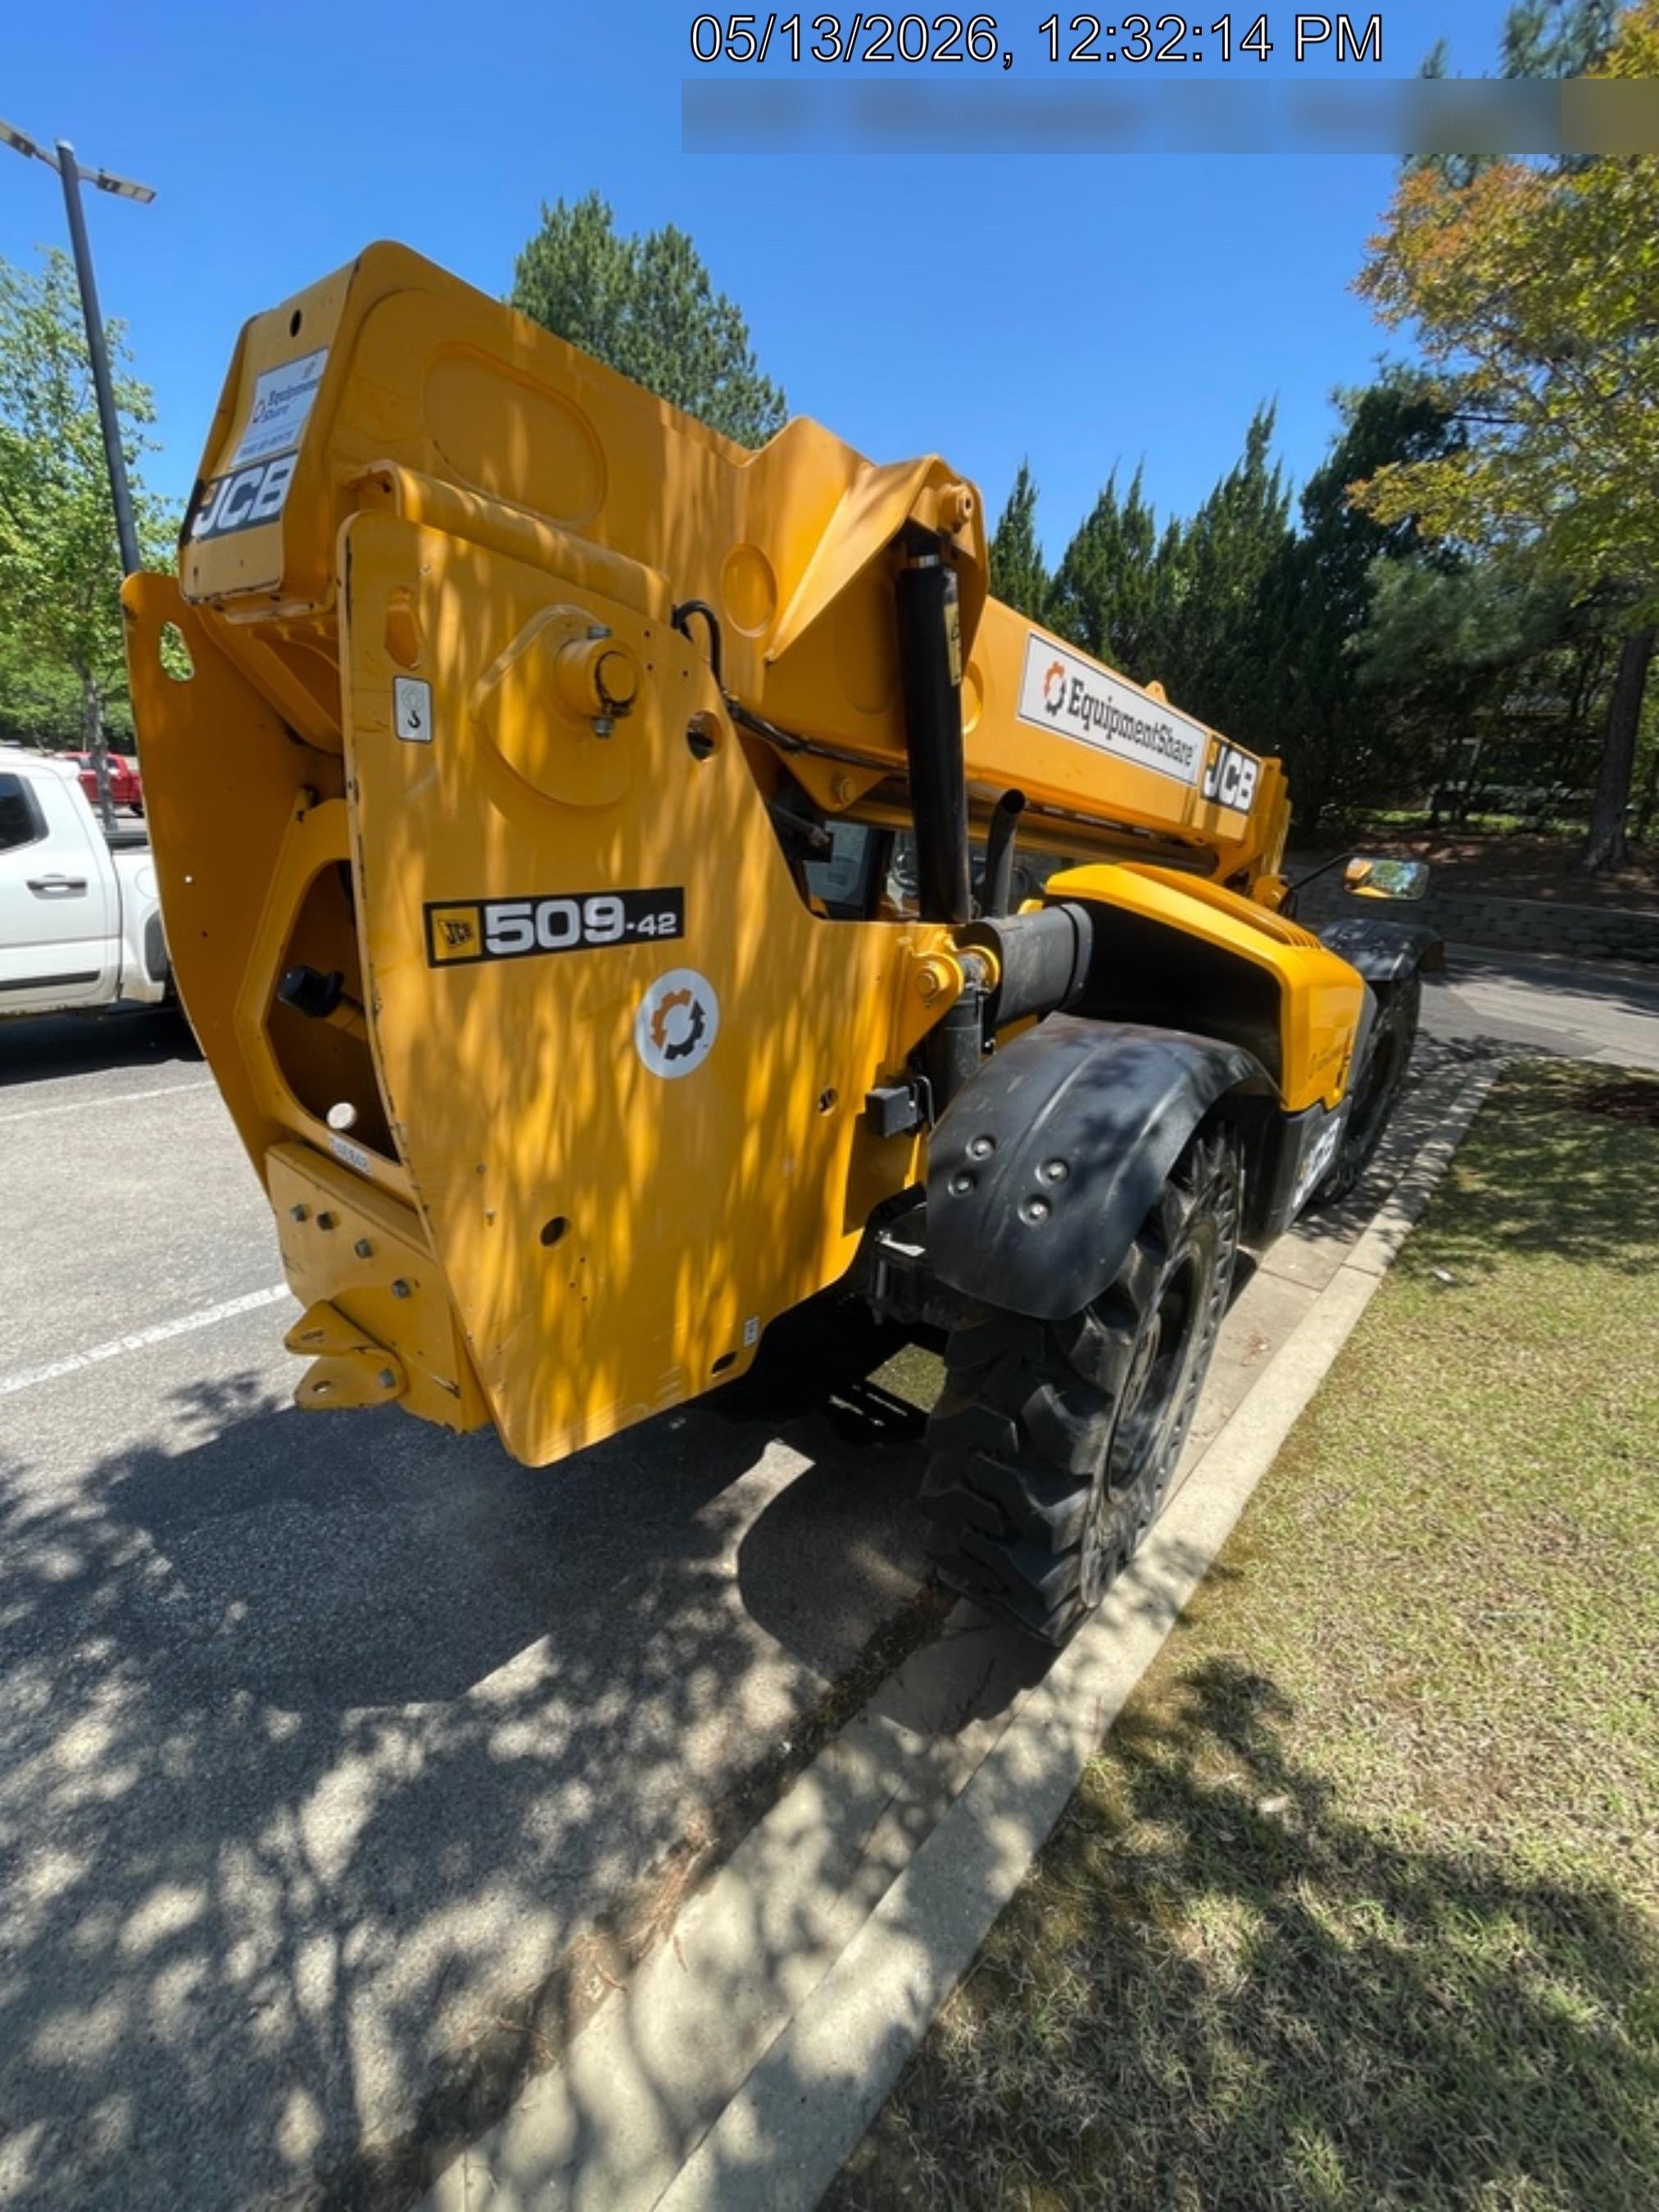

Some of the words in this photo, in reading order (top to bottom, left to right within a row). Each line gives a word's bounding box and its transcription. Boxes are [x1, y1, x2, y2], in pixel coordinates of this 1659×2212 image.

[191, 453, 296, 537] JCB
[1067, 678, 1193, 767] EquipmentShare
[1203, 741, 1258, 810] JCB
[438, 920, 472, 947] JCB
